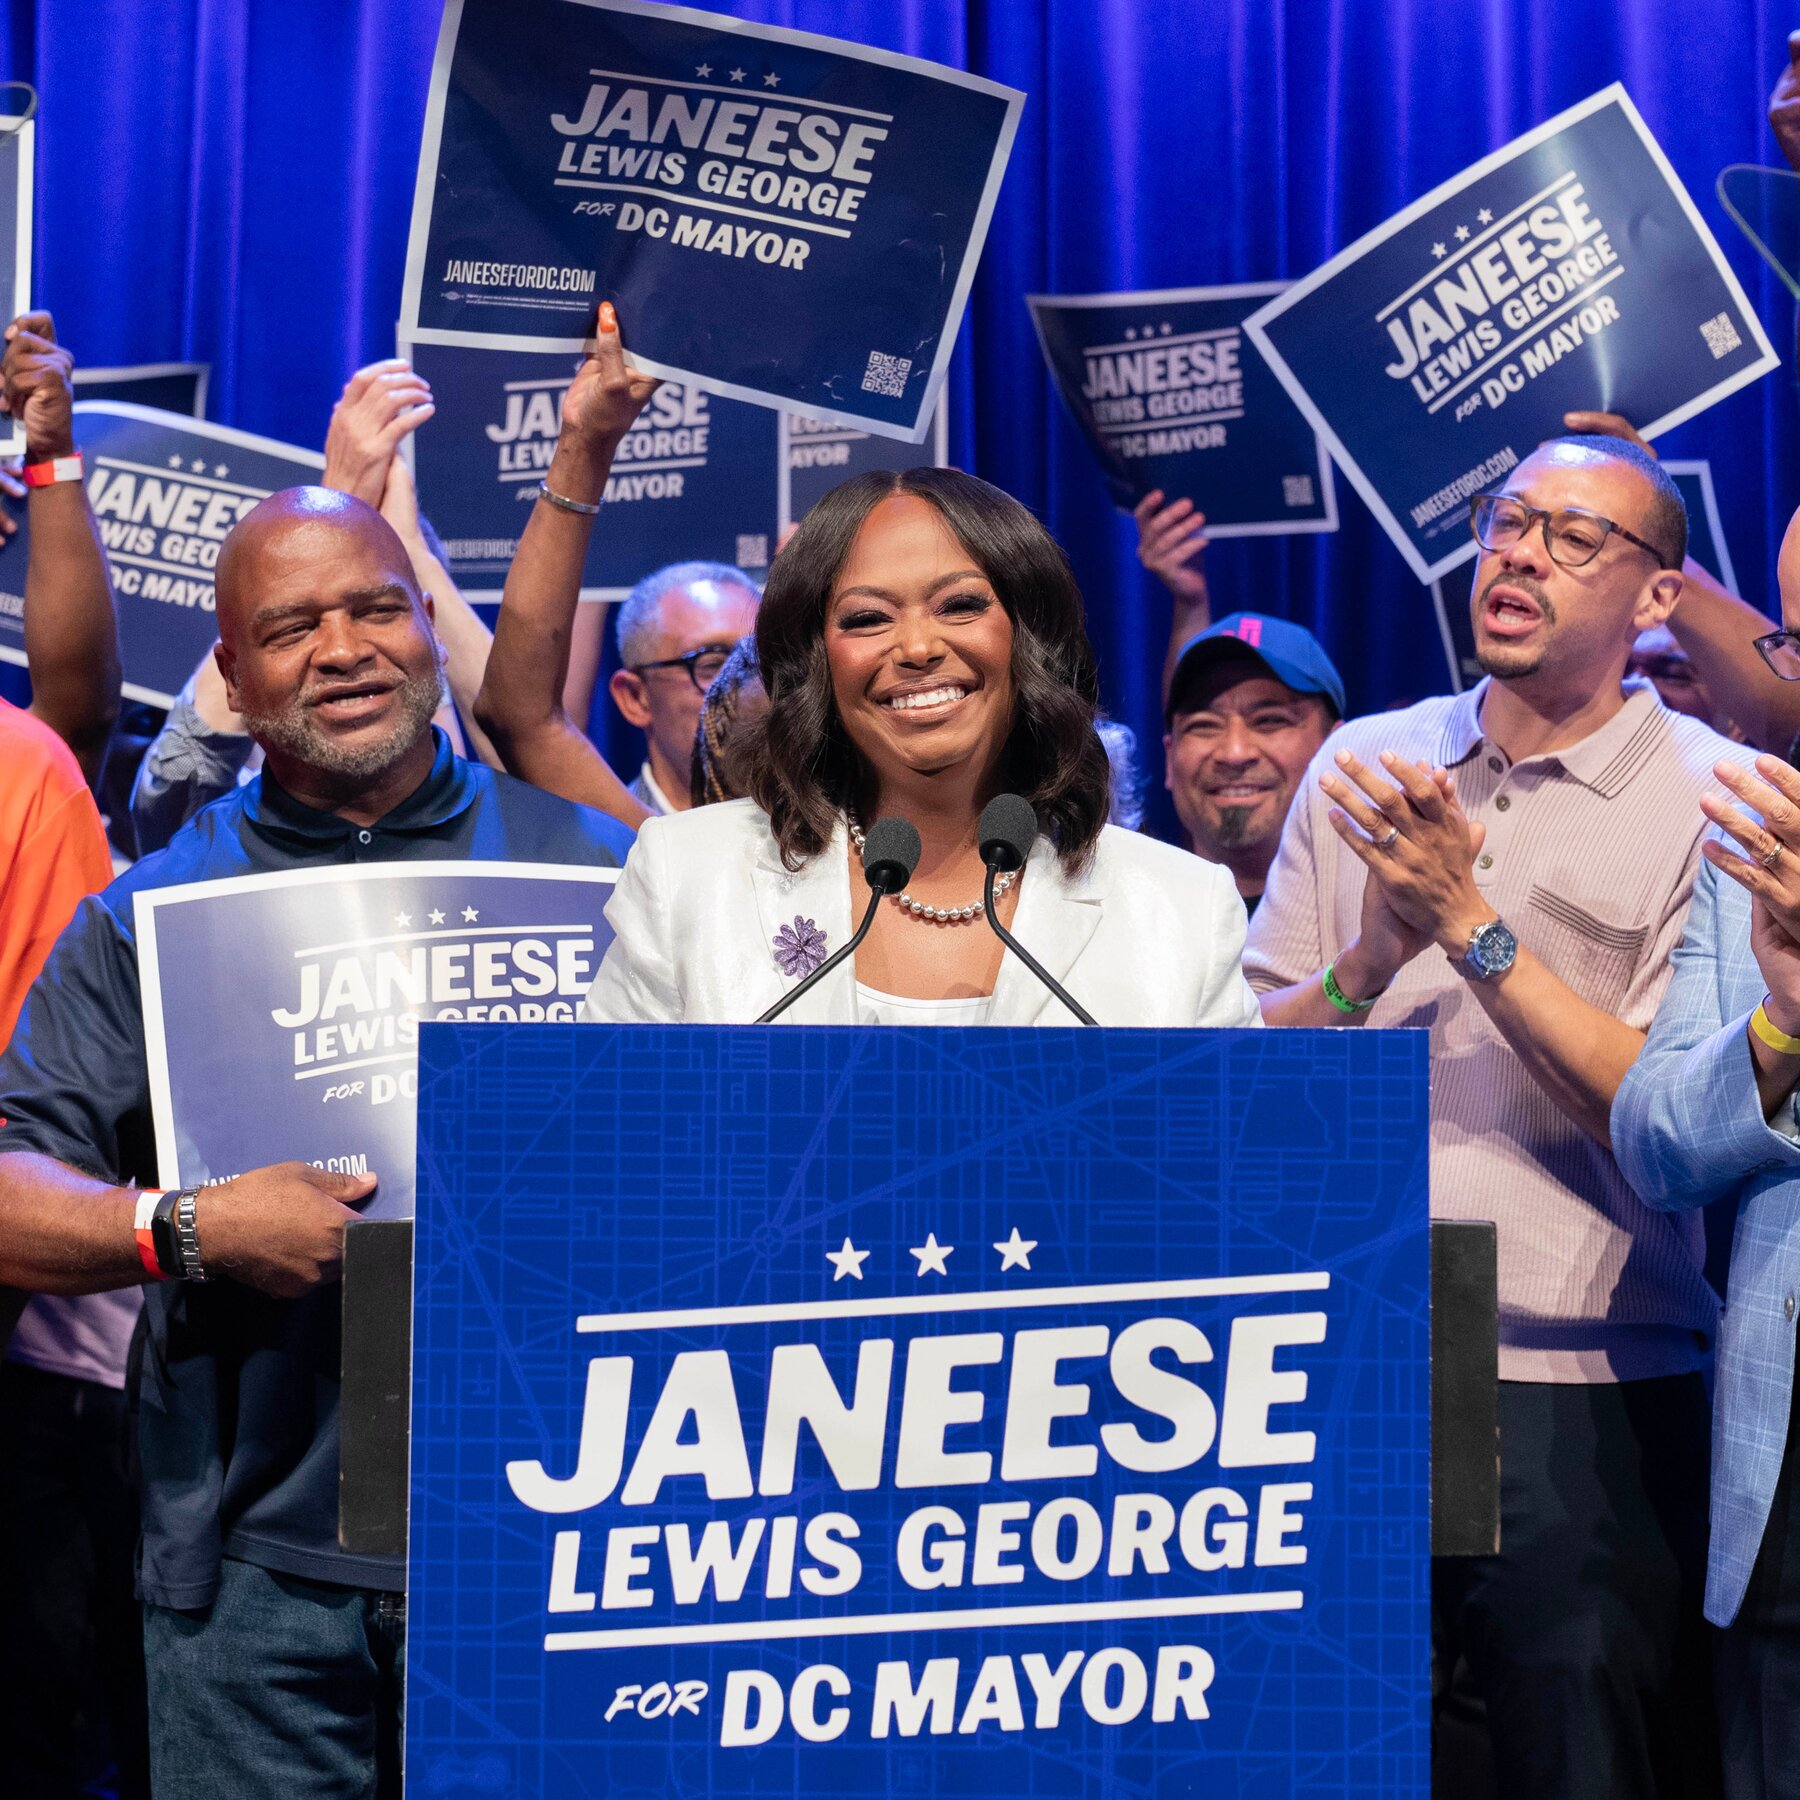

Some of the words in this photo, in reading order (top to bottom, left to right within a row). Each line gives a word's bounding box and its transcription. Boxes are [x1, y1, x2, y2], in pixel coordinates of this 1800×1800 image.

[550, 84, 889, 184] JANEESE
[557, 142, 687, 186] LEWIS
[697, 158, 866, 222] GEORGE
[573, 200, 616, 218] FOR
[616, 201, 670, 239] DC
[671, 216, 811, 271] MAYOR
[443, 259, 597, 293] JANEESEFORDC.COM
[1384, 182, 1603, 379] JANEESE
[1411, 314, 1502, 404] LEWIS
[1507, 232, 1618, 332] GEORGE
[1082, 337, 1242, 400] JANEESE
[1455, 393, 1484, 422] FOR
[1481, 362, 1526, 410] DC
[1521, 294, 1621, 379] MAYOR
[485, 382, 711, 443] JASE
[1147, 381, 1244, 422] GEORGE
[498, 440, 557, 471] LEW
[613, 426, 710, 461] EORGE
[790, 440, 850, 469] AYOR
[1148, 424, 1228, 458] MAYOR
[87, 467, 260, 542] ANEE
[97, 517, 157, 556] WIS
[160, 532, 221, 569] GEO
[140, 572, 217, 613] MAYO
[271, 938, 595, 1028] JANEESE
[294, 1012, 419, 1066] LEWIS
[322, 1081, 365, 1103] FOR
[506, 1311, 1328, 1514] JANEESE
[548, 1511, 862, 1613] LEWIS
[897, 1481, 1313, 1592] GEORGE
[604, 1678, 709, 1722] FOR
[720, 1664, 851, 1747] DC
[870, 1644, 1216, 1740] MAYOR
